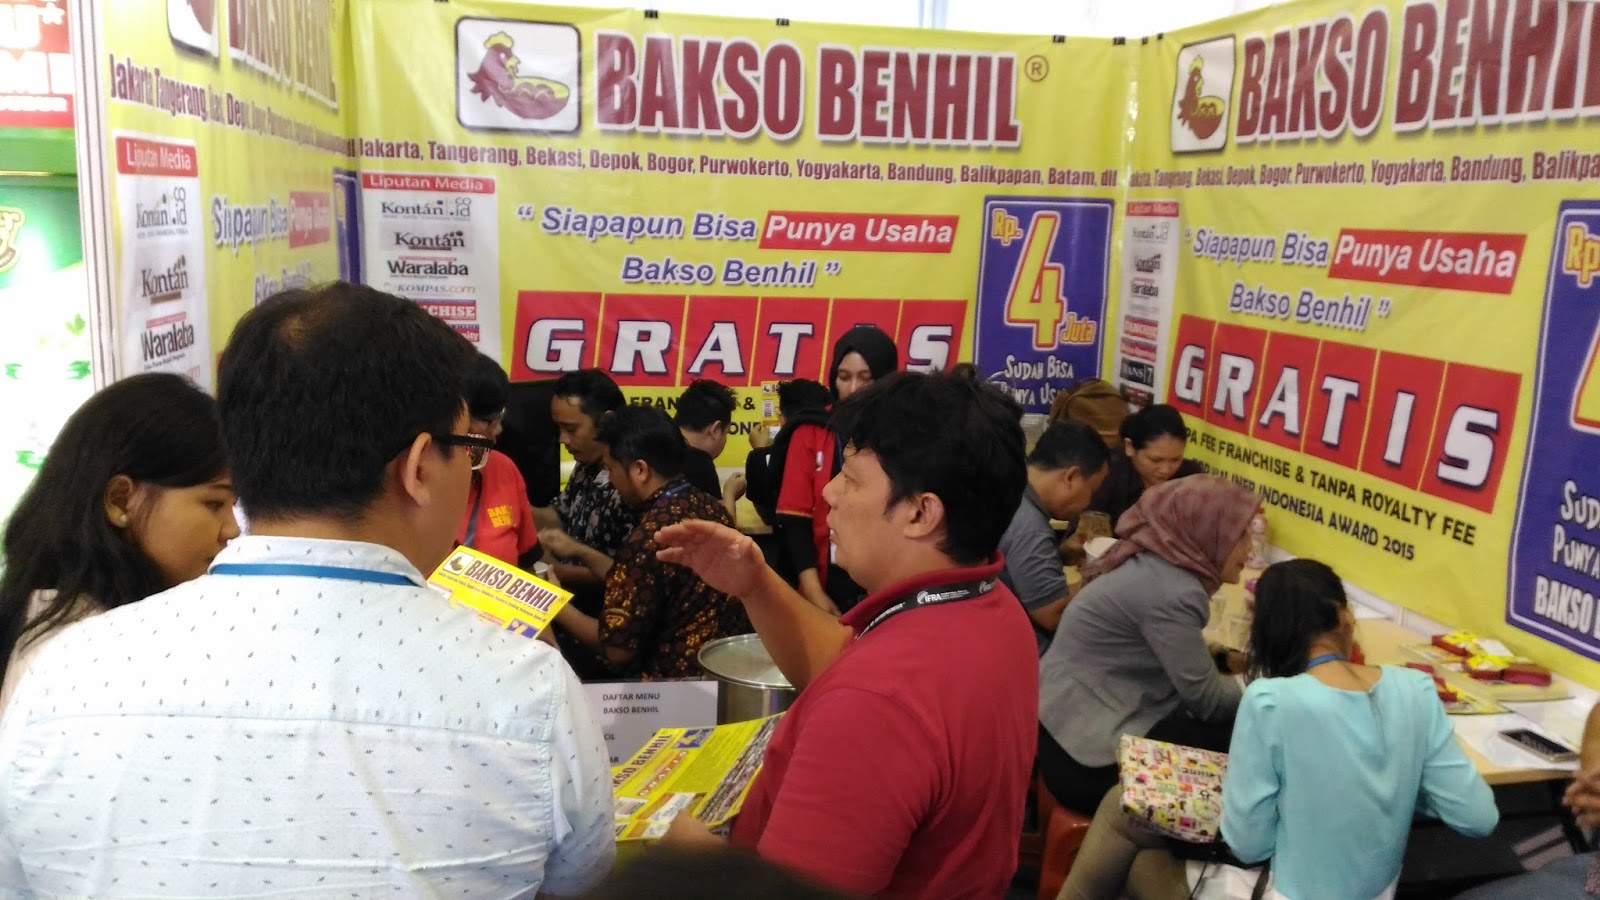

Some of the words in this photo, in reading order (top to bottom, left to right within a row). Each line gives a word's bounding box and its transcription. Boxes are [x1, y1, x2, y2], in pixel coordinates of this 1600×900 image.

[594, 31, 803, 139] BAKSO
[816, 46, 1020, 144] BENHIL
[1235, 9, 1390, 142] BAKSO
[359, 138, 424, 161] Jakarta,
[427, 141, 522, 166] Tangerang,
[526, 146, 586, 169] Bekasi,
[589, 149, 643, 172] Depok,
[647, 152, 696, 175] Bogor,
[700, 154, 792, 178] Purwokerto,
[796, 159, 884, 182] Yogyakarta,
[887, 162, 956, 184] Bandung,
[960, 164, 1044, 186] Balikpapan,
[1048, 167, 1097, 187] Batam,
[1100, 168, 1118, 187] dll
[370, 174, 431, 189] Liputan
[435, 176, 483, 191] Media
[1295, 161, 1367, 185] Purwokerto,
[1371, 158, 1447, 186] Yogyakarta,
[1450, 154, 1527, 183] Bandung,
[540, 206, 684, 240] Siapapun
[692, 211, 758, 240] Bisa
[765, 217, 855, 246] Punya
[864, 217, 953, 244] Usaha
[387, 260, 469, 276] Waralaba
[621, 256, 714, 284] Bakso
[722, 258, 815, 286] Benhil
[1193, 229, 1276, 264] Siapapun
[1281, 231, 1330, 266] Bisa
[1334, 234, 1412, 277] Punya
[1418, 237, 1517, 279] Usaha
[1004, 210, 1068, 351] 4
[1060, 312, 1097, 344] Juta
[425, 304, 476, 318] CHISE
[1229, 282, 1290, 317] Bakso
[1296, 288, 1371, 329] Benhil
[141, 321, 194, 362] Waralaba
[523, 317, 954, 376] GRATS
[1173, 344, 1500, 490] GRATIS
[1218, 440, 1290, 479] FRANCHISE
[1294, 466, 1305, 484] &
[1310, 470, 1357, 502] TANPA
[1361, 488, 1437, 530] ROYALTY
[1441, 517, 1477, 546] FEE
[1258, 484, 1324, 525] INDONESIA
[1328, 512, 1379, 546] AWARD
[1383, 536, 1415, 561] 2015
[464, 559, 514, 590] BAKSO
[505, 577, 559, 612] BENHIL
[924, 592, 942, 604] IFRA
[1534, 574, 1594, 634] BAKSO
[602, 693, 634, 701] DAFTAR
[635, 692, 660, 700] MENU
[603, 706, 630, 714] BAKSO
[631, 706, 659, 714] BENHIL
[604, 733, 616, 741] CIL
[631, 734, 672, 766] BENHIL
